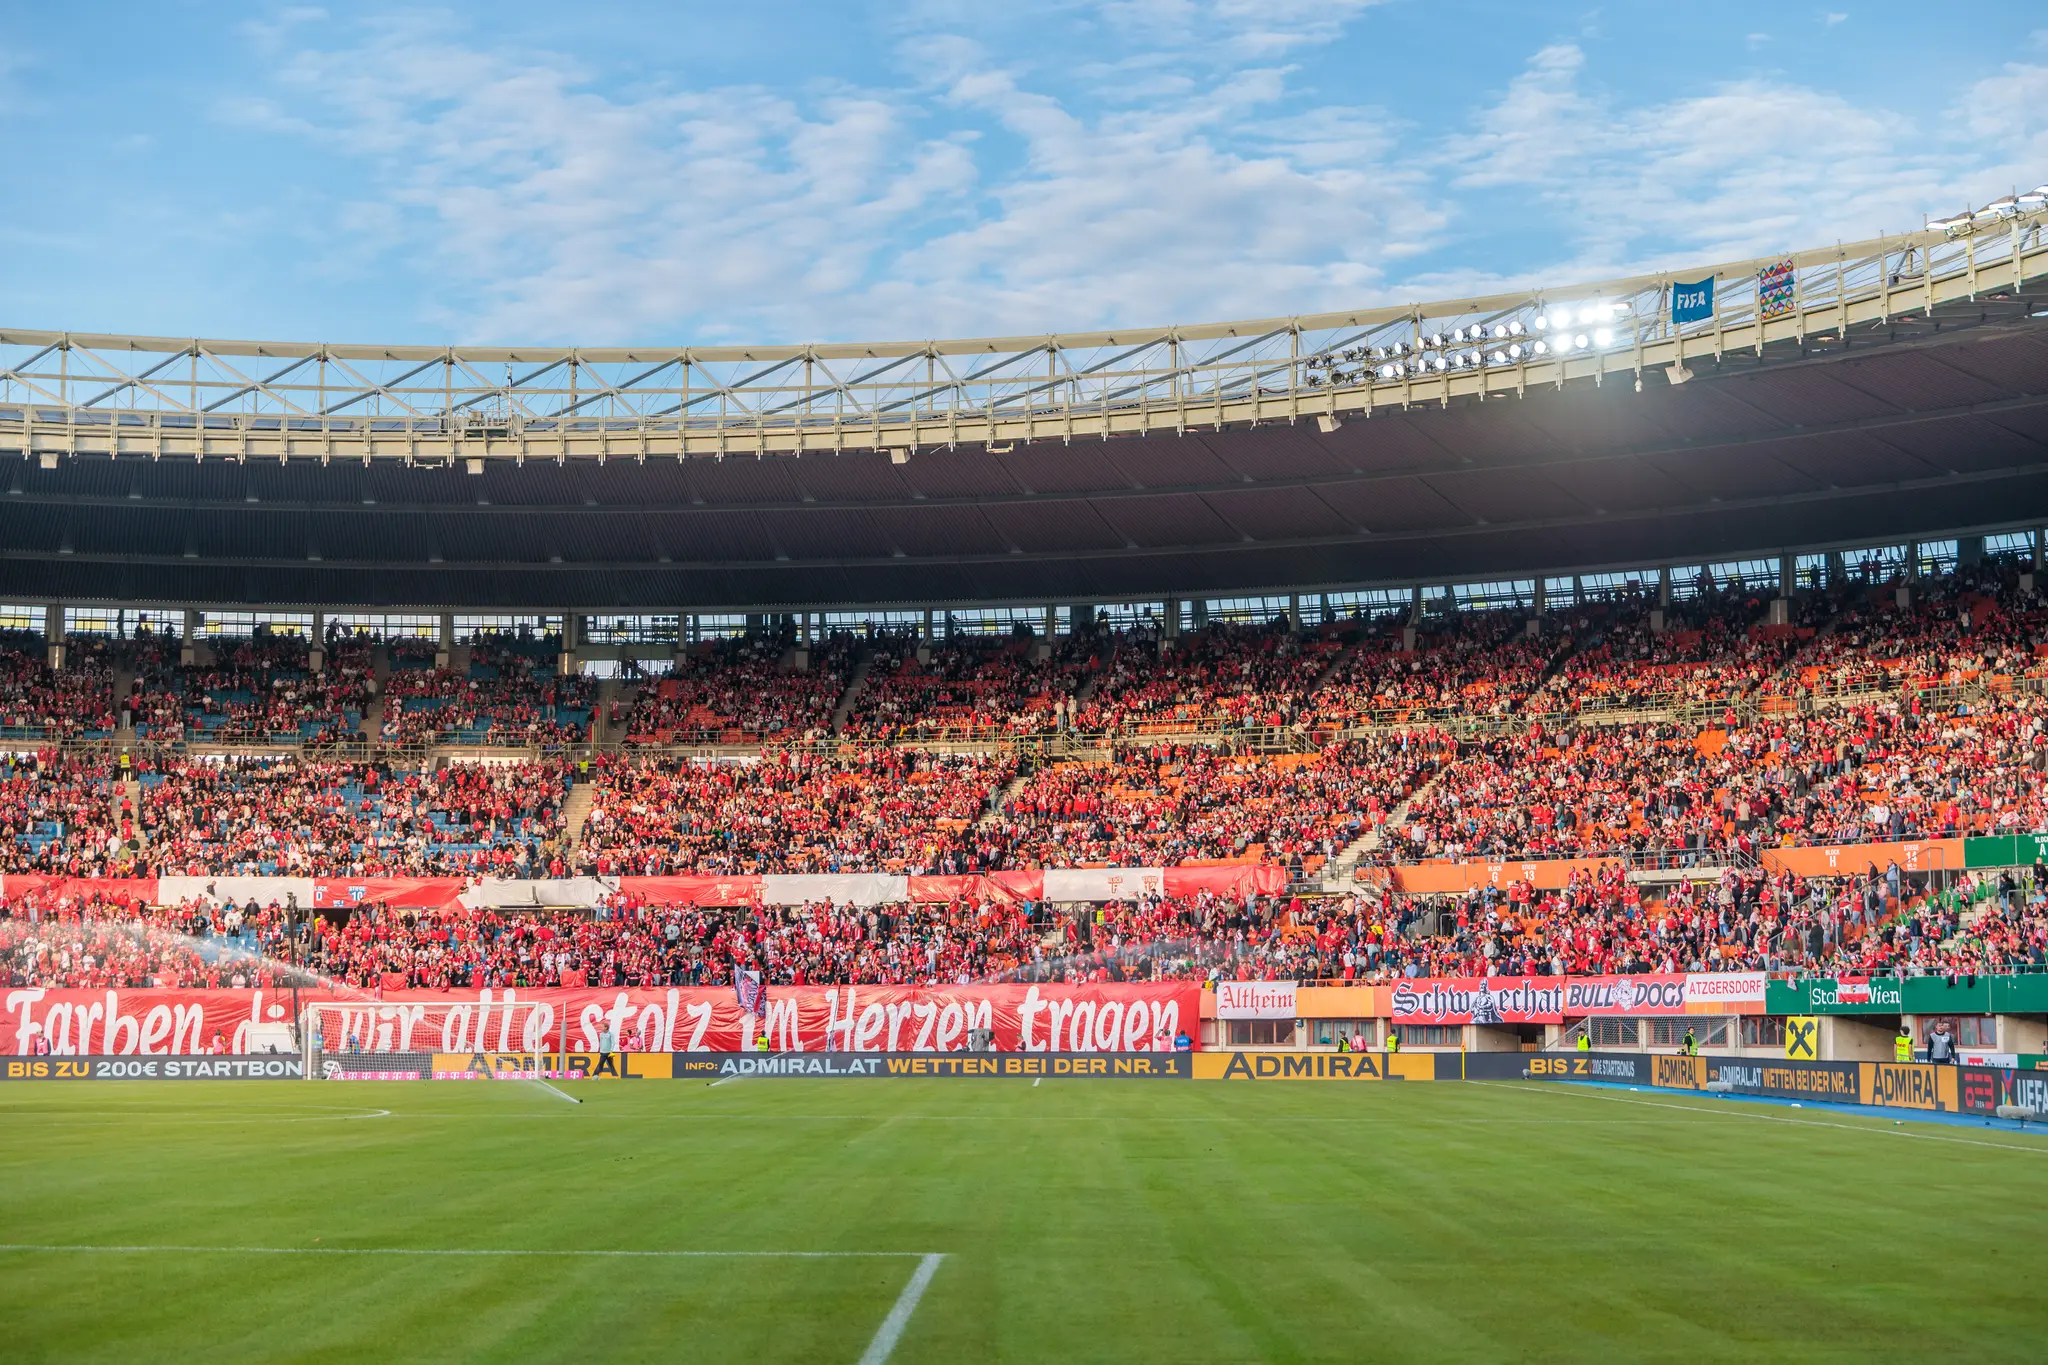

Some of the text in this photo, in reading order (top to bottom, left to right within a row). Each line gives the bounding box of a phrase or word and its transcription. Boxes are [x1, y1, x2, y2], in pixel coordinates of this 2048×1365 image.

[1677, 291, 1706, 310] FIFA
[2035, 836, 2048, 844] BLOC
[1906, 851, 1918, 863] 14
[2039, 843, 2047, 856] A
[1829, 856, 1836, 868] H
[1492, 872, 1498, 882] G
[1524, 870, 1535, 881] 13
[352, 891, 363, 901] 10
[721, 890, 728, 899] E
[755, 890, 765, 899] 11
[1568, 981, 1685, 1008] BULL DOGS
[1689, 979, 1762, 995] ATZGERSDORF
[1219, 985, 1294, 1016] Altheim
[442, 988, 554, 1053] alle
[576, 988, 712, 1053] stolz
[825, 987, 996, 1052] Herzen
[1017, 986, 1179, 1052] tragen
[8, 1060, 338, 1077] BIS ZU 200€ STARTBONS
[685, 1058, 1179, 1074] INFO: ADMIRAL.AT WETTEN BEI DER NR. 1
[1222, 1052, 1405, 1080] ADMIRAL
[1529, 1058, 1568, 1074] BIS
[1603, 1060, 1634, 1077] STARTBONUS
[1657, 1055, 1700, 1089] ADMIRAL
[1719, 1066, 1762, 1087] ADMIRAL.AT
[1762, 1068, 1795, 1090] WETTEN
[1797, 1070, 1810, 1091] BEI
[1811, 1071, 1830, 1092] DER
[1831, 1072, 1848, 1094] NR.
[1849, 1072, 1856, 1094] 1
[1872, 1063, 1946, 1111] ADMIRAL
[2016, 1079, 2048, 1114] UEFA
